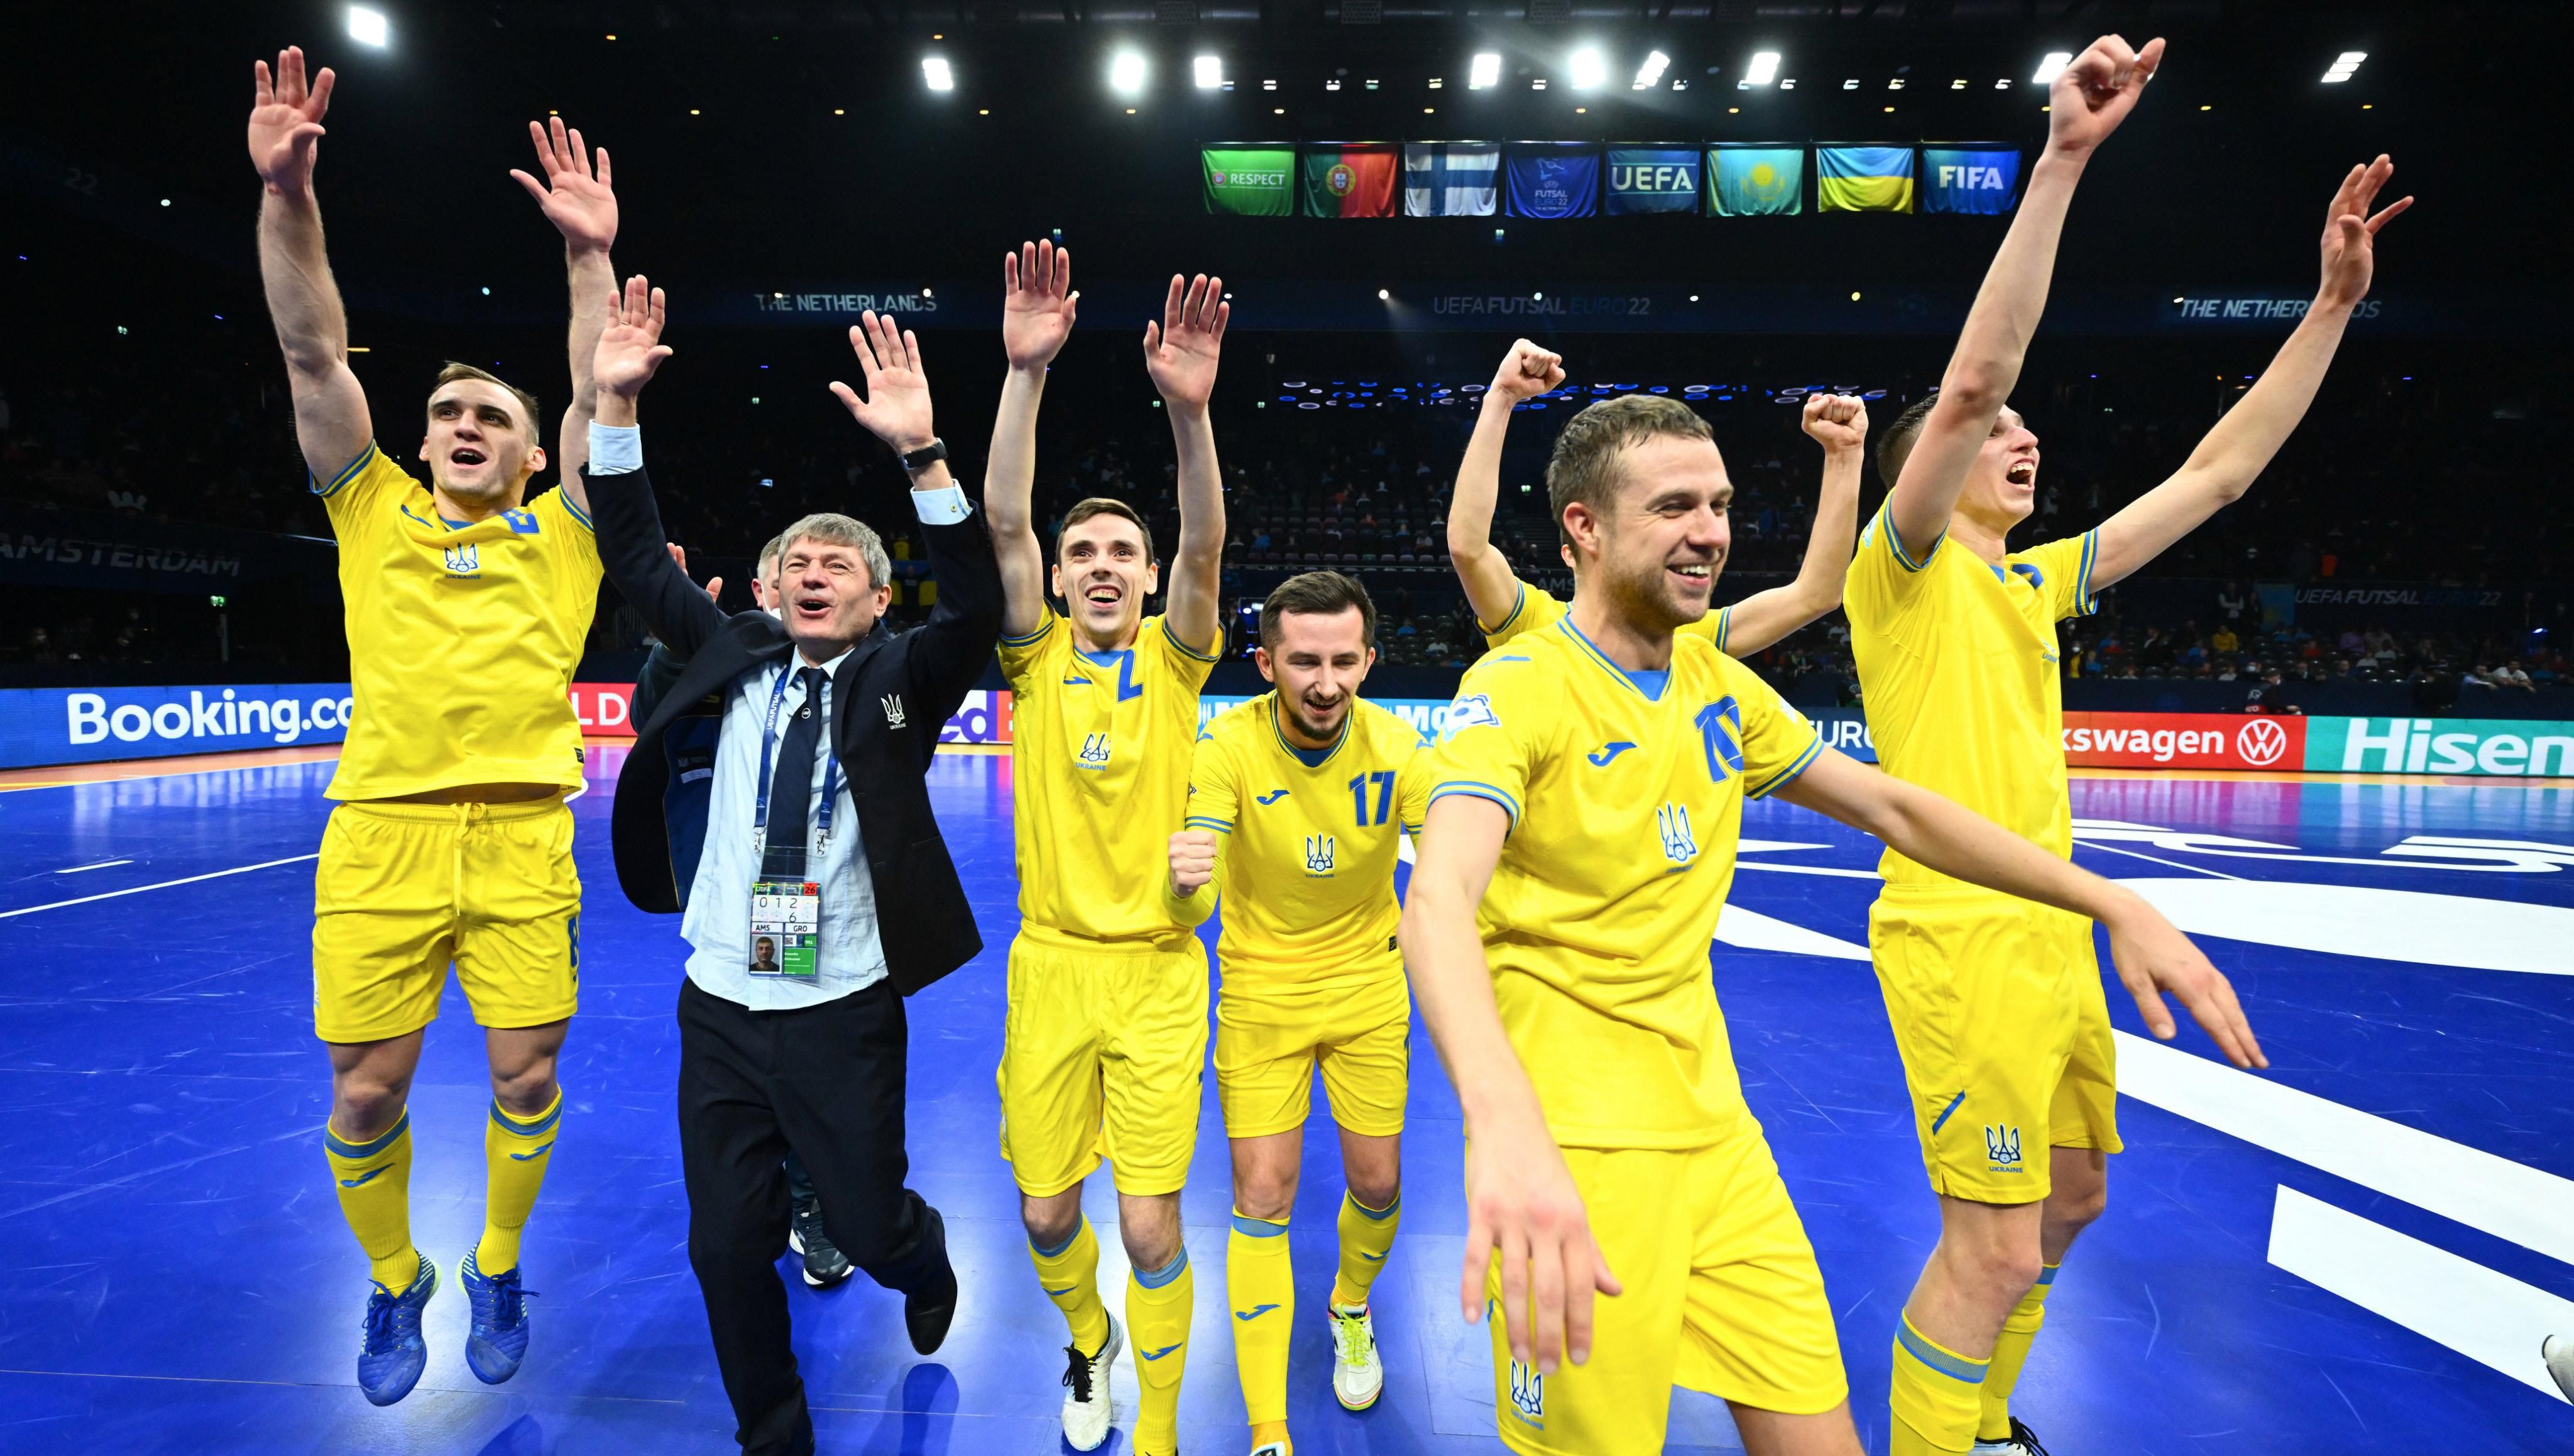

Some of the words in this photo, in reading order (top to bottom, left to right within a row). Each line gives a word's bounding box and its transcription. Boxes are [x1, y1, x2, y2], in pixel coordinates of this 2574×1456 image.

[1230, 173, 1284, 185] RESPECT
[1612, 167, 1693, 190] UEFA
[1939, 166, 2003, 190] FIFA
[1535, 190, 1568, 198] FUTSAL
[754, 294, 792, 311] THE
[796, 293, 937, 312] NETHERLANDS
[1433, 297, 1484, 314] UEFA
[1487, 297, 1567, 314] FUTSAL
[2181, 299, 2221, 317] THE
[2223, 299, 2382, 319] NETHERDS
[2295, 588, 2342, 604] UEFA
[2344, 589, 2419, 605] FUTSAL
[1809, 720, 1875, 748] UR
[2342, 718, 2574, 775] Hisen
[1076, 762, 1106, 770] UKRAINE
[1349, 770, 1397, 827] 17
[789, 912, 797, 922] 6
